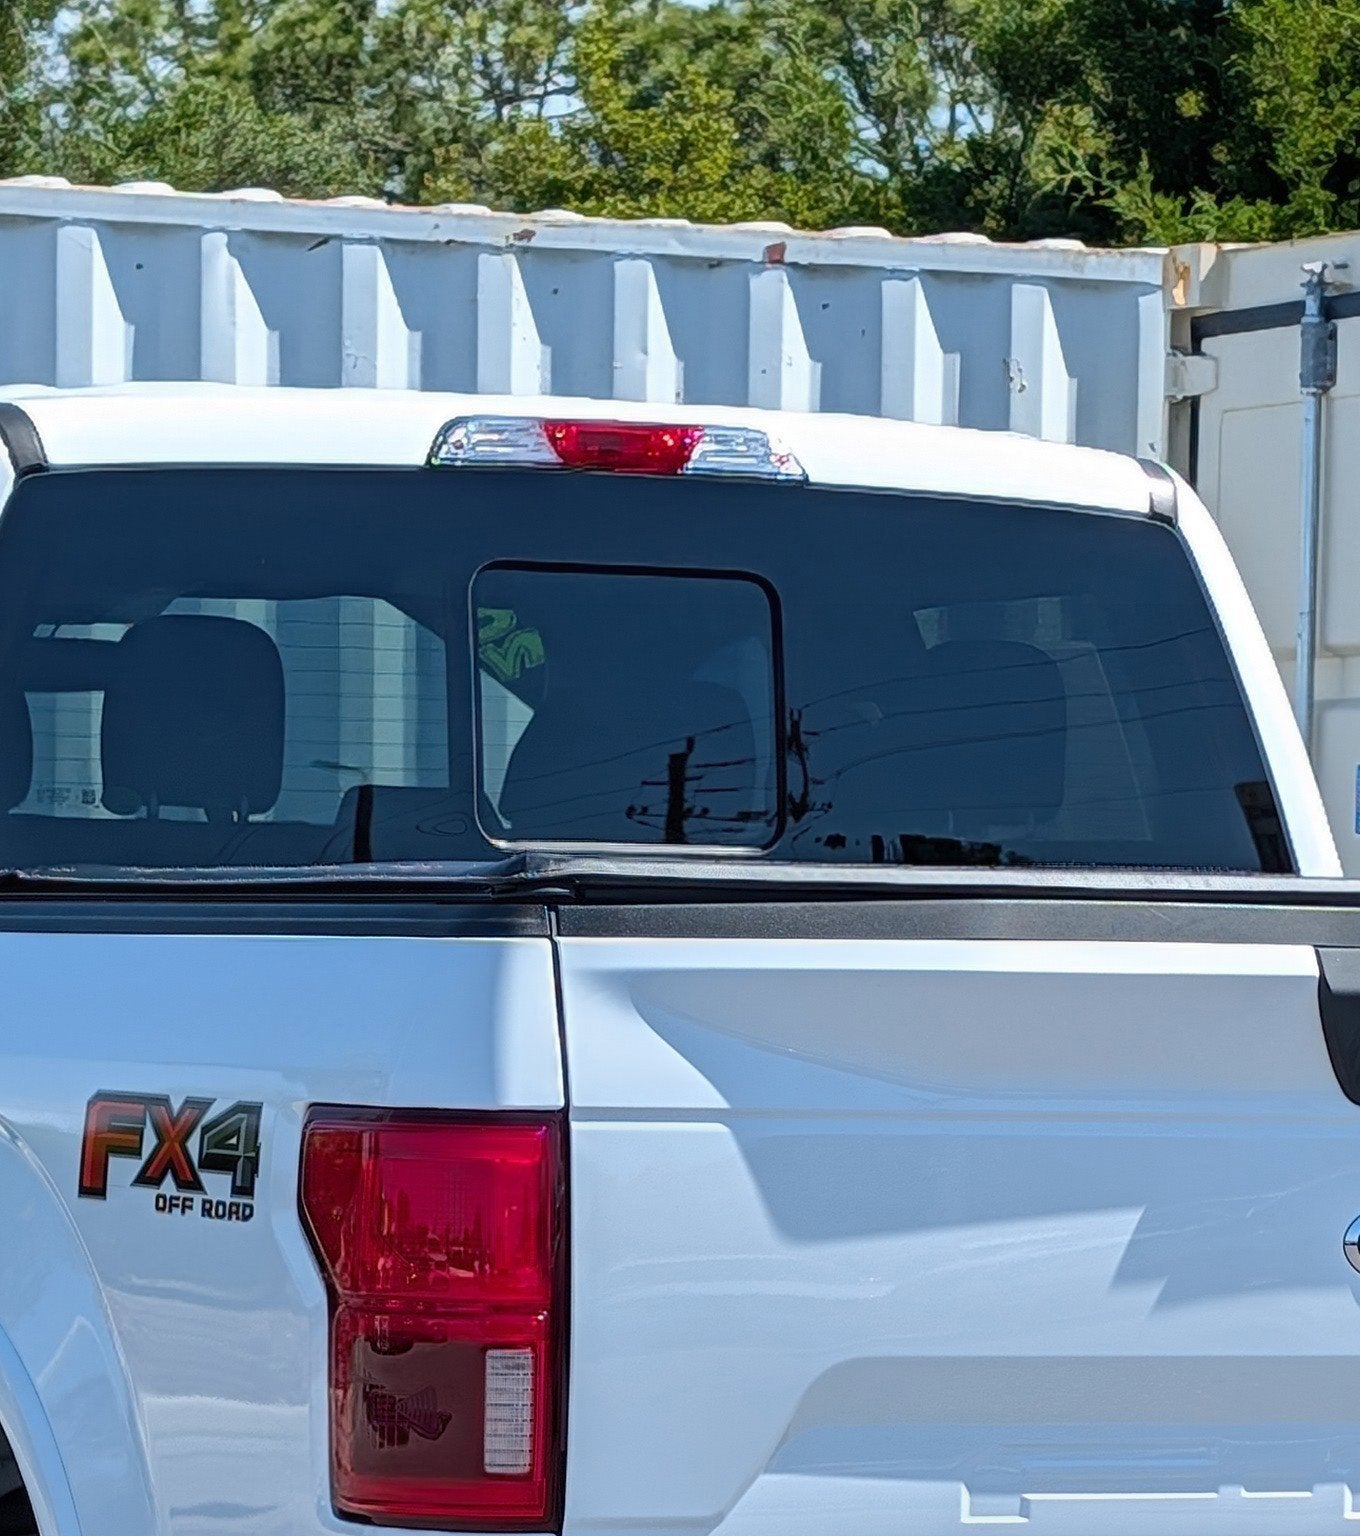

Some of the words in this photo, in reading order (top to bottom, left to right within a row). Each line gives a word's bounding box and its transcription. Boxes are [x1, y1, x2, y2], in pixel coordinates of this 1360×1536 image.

[78, 1089, 264, 1200] FX4
[155, 1193, 194, 1216] OFF
[201, 1197, 255, 1223] ROAD
